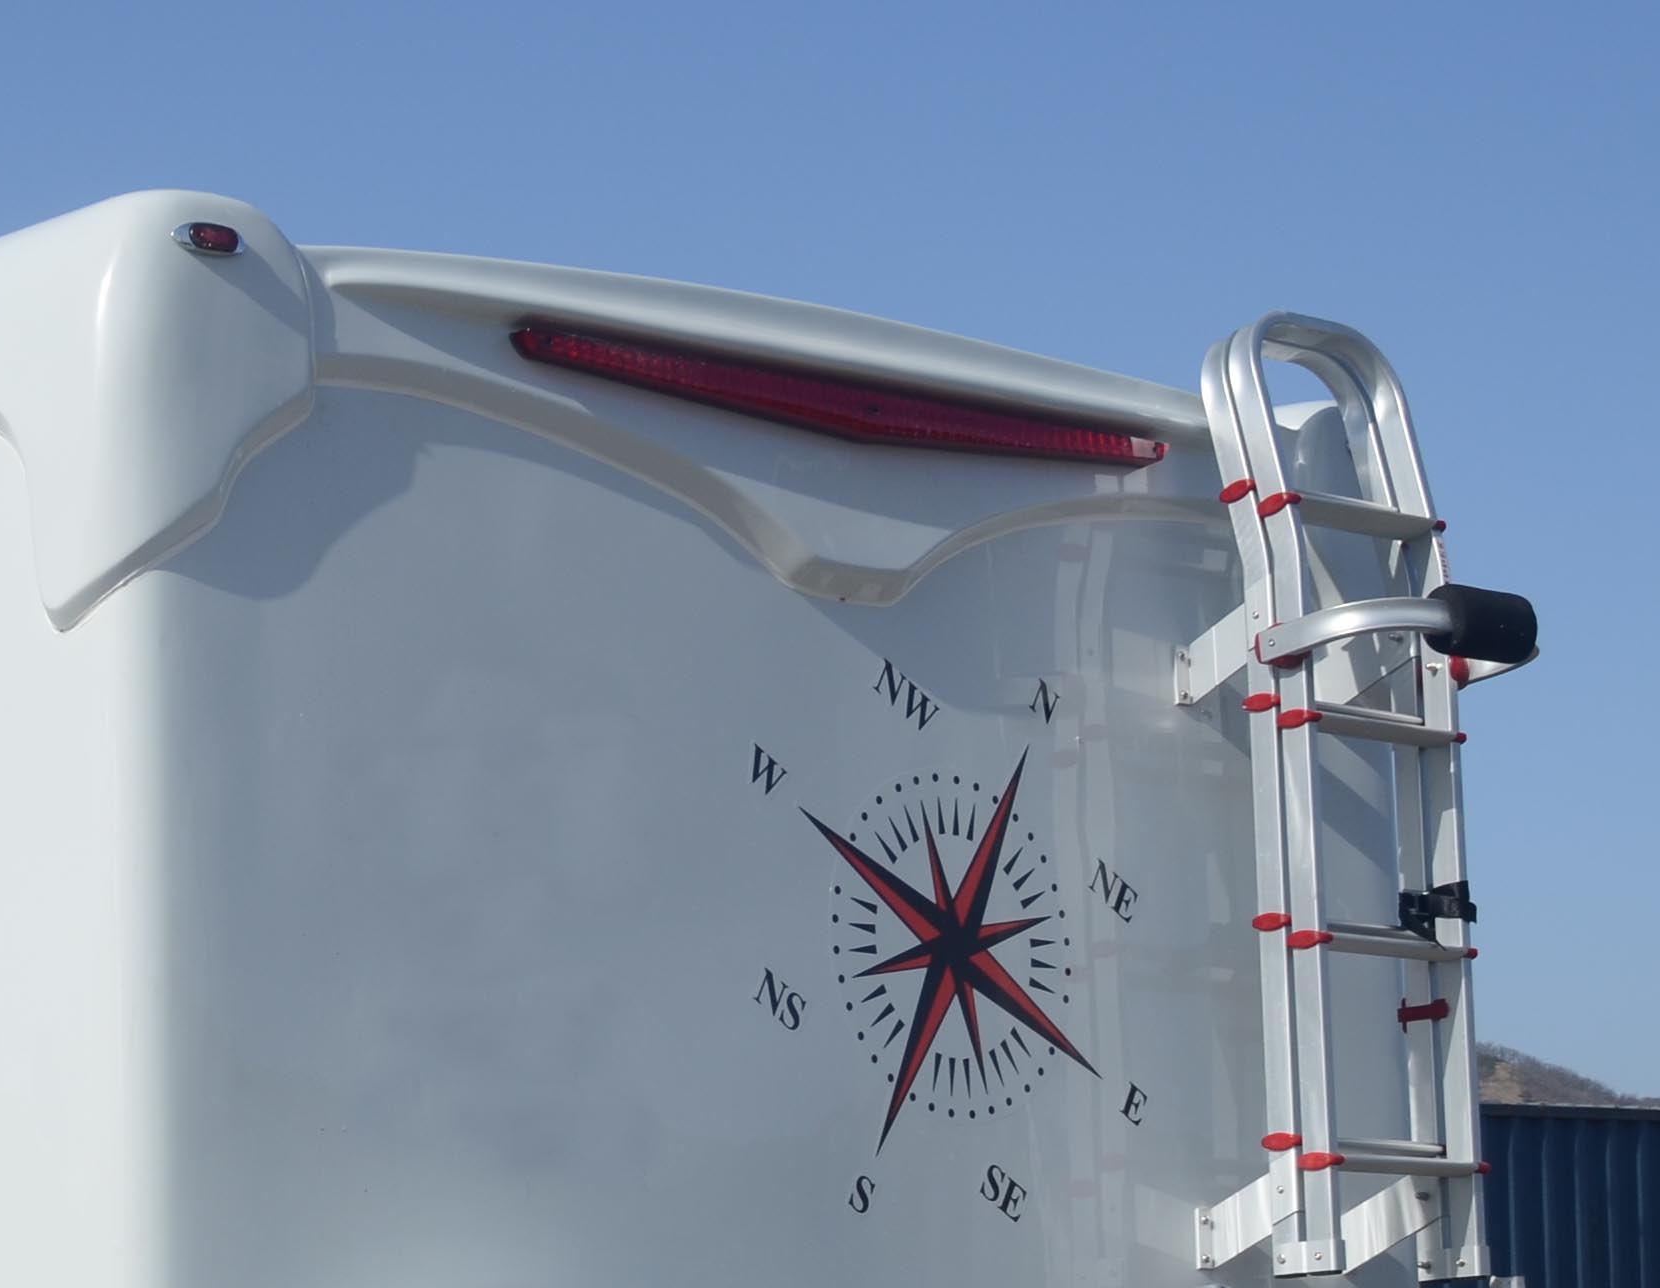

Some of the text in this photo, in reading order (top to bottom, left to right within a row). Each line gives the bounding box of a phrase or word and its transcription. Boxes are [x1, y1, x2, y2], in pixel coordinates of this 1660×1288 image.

[873, 657, 940, 730] NW
[1029, 678, 1060, 724] N
[752, 744, 787, 795] W
[1089, 859, 1138, 923] NE
[753, 968, 806, 1030] NS
[1120, 1082, 1147, 1126] E
[849, 1176, 875, 1213] S
[980, 1165, 1027, 1222] SE
